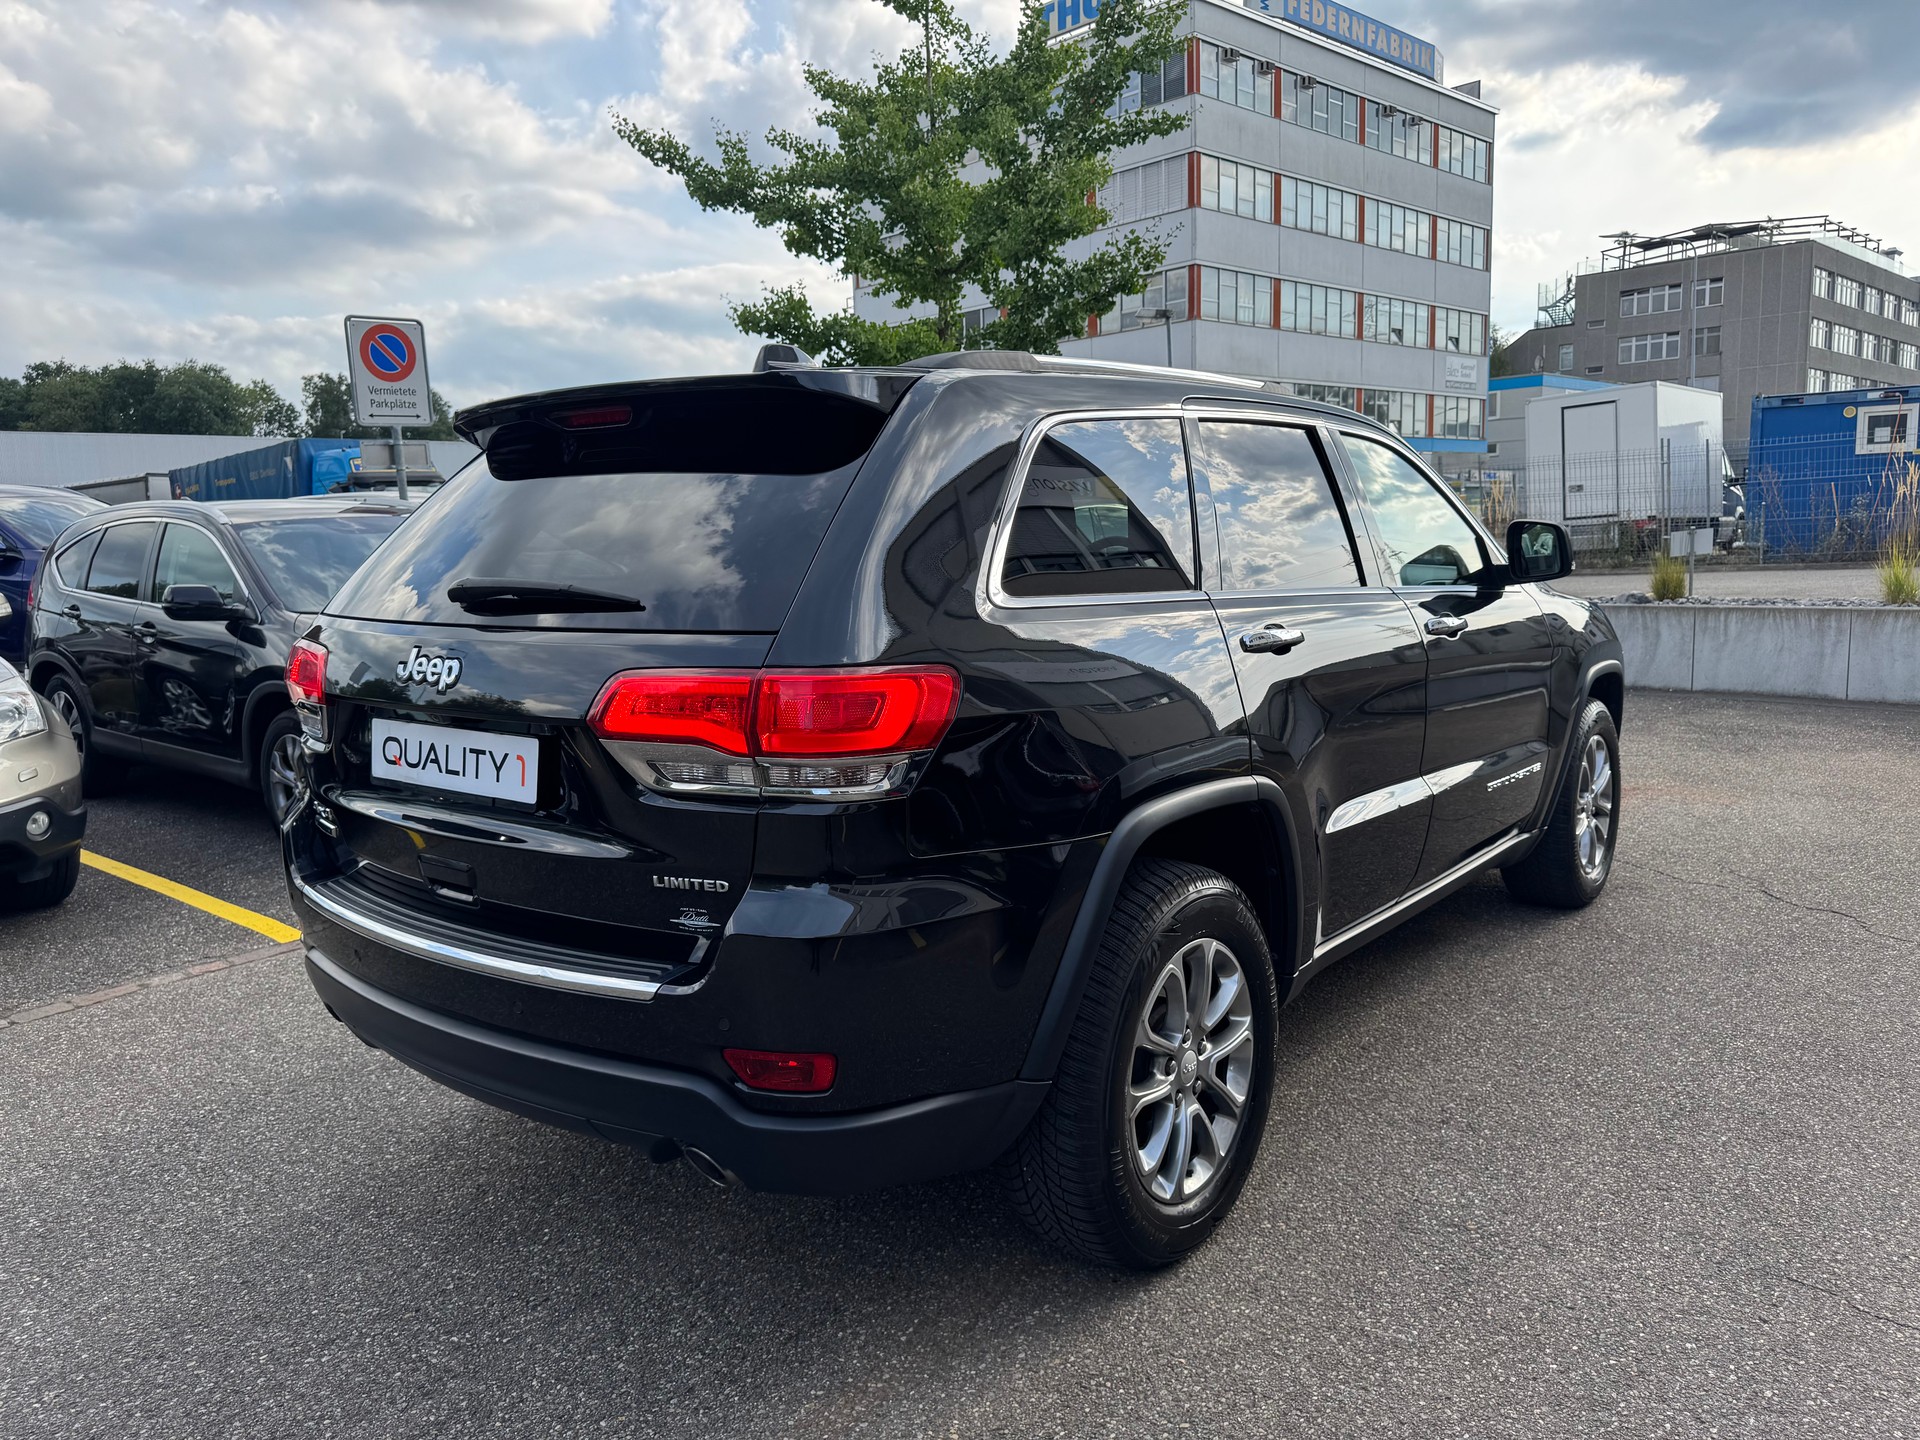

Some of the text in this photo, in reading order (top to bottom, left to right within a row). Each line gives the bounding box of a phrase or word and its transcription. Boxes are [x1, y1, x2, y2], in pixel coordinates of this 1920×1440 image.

[1287, 0, 1433, 73] FEDERNFABRIK
[367, 385, 417, 396] Vermietete
[370, 398, 417, 410] Parkplätze
[397, 645, 464, 695] Jeep
[652, 875, 729, 892] LIMITED
